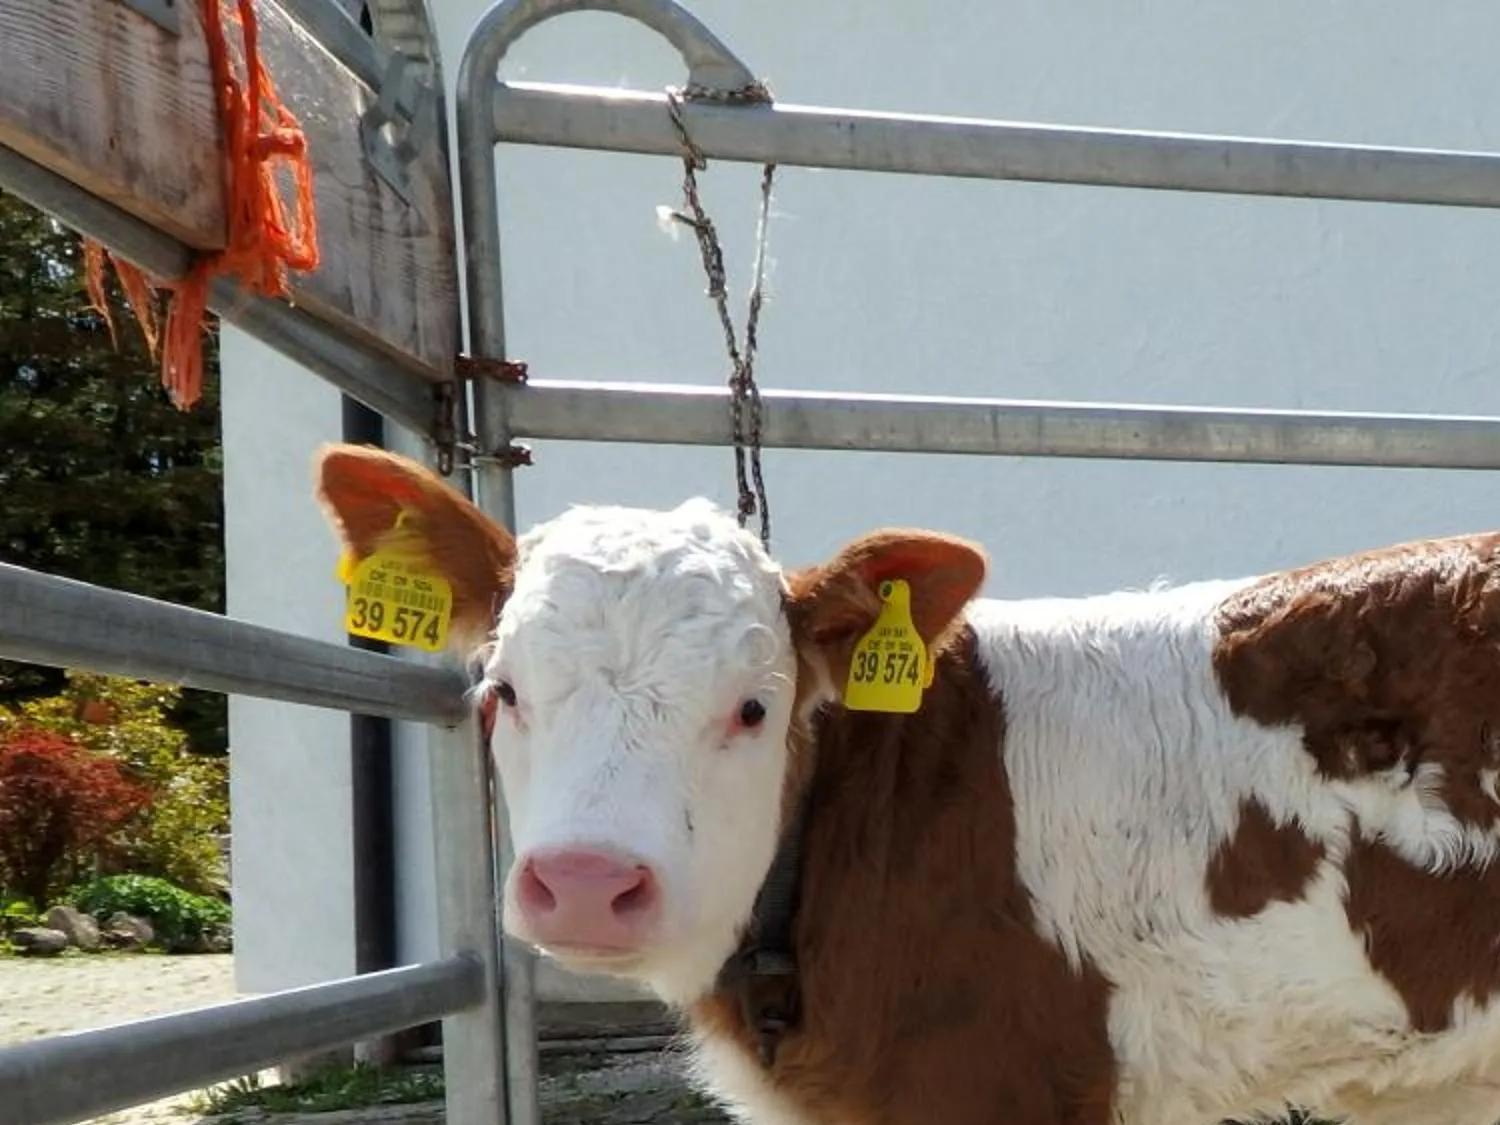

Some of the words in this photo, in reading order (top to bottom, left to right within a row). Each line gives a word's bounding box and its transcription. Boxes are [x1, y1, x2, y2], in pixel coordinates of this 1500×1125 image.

[351, 597, 384, 632] 39
[391, 607, 440, 646] 574
[854, 651, 879, 682] 39
[883, 652, 919, 686] 574
